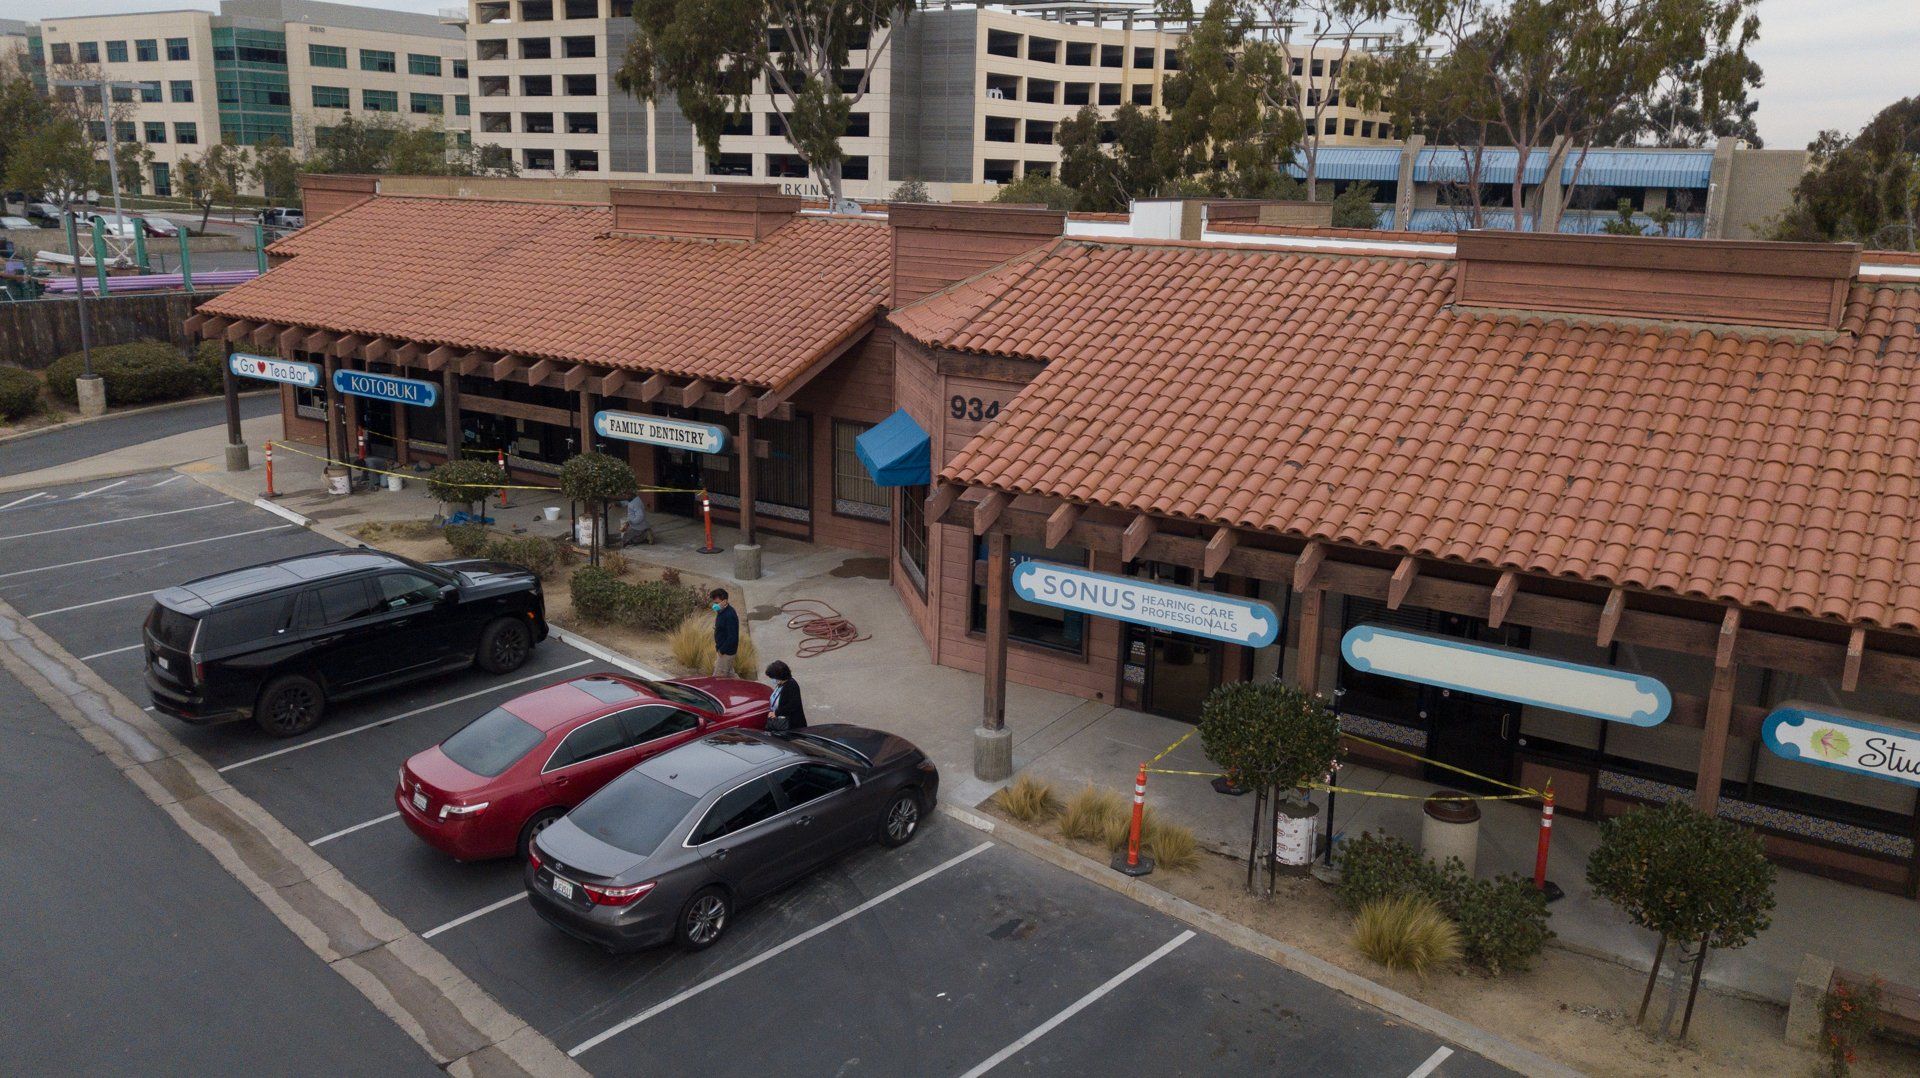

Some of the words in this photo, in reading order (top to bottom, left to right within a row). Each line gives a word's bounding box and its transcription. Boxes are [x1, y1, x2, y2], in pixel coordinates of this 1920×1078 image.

[240, 359, 255, 373] Go
[269, 362, 287, 379] Tea
[289, 366, 306, 381] Bar
[351, 376, 417, 400] KOTOBUKI
[610, 419, 645, 436] FAMILY
[649, 425, 705, 445] DENTISTRY
[1043, 575, 1136, 611] SONUS
[1141, 606, 1238, 633] PROFESSIONALS
[1142, 594, 1196, 613] HEARING
[1200, 605, 1234, 620] CARE
